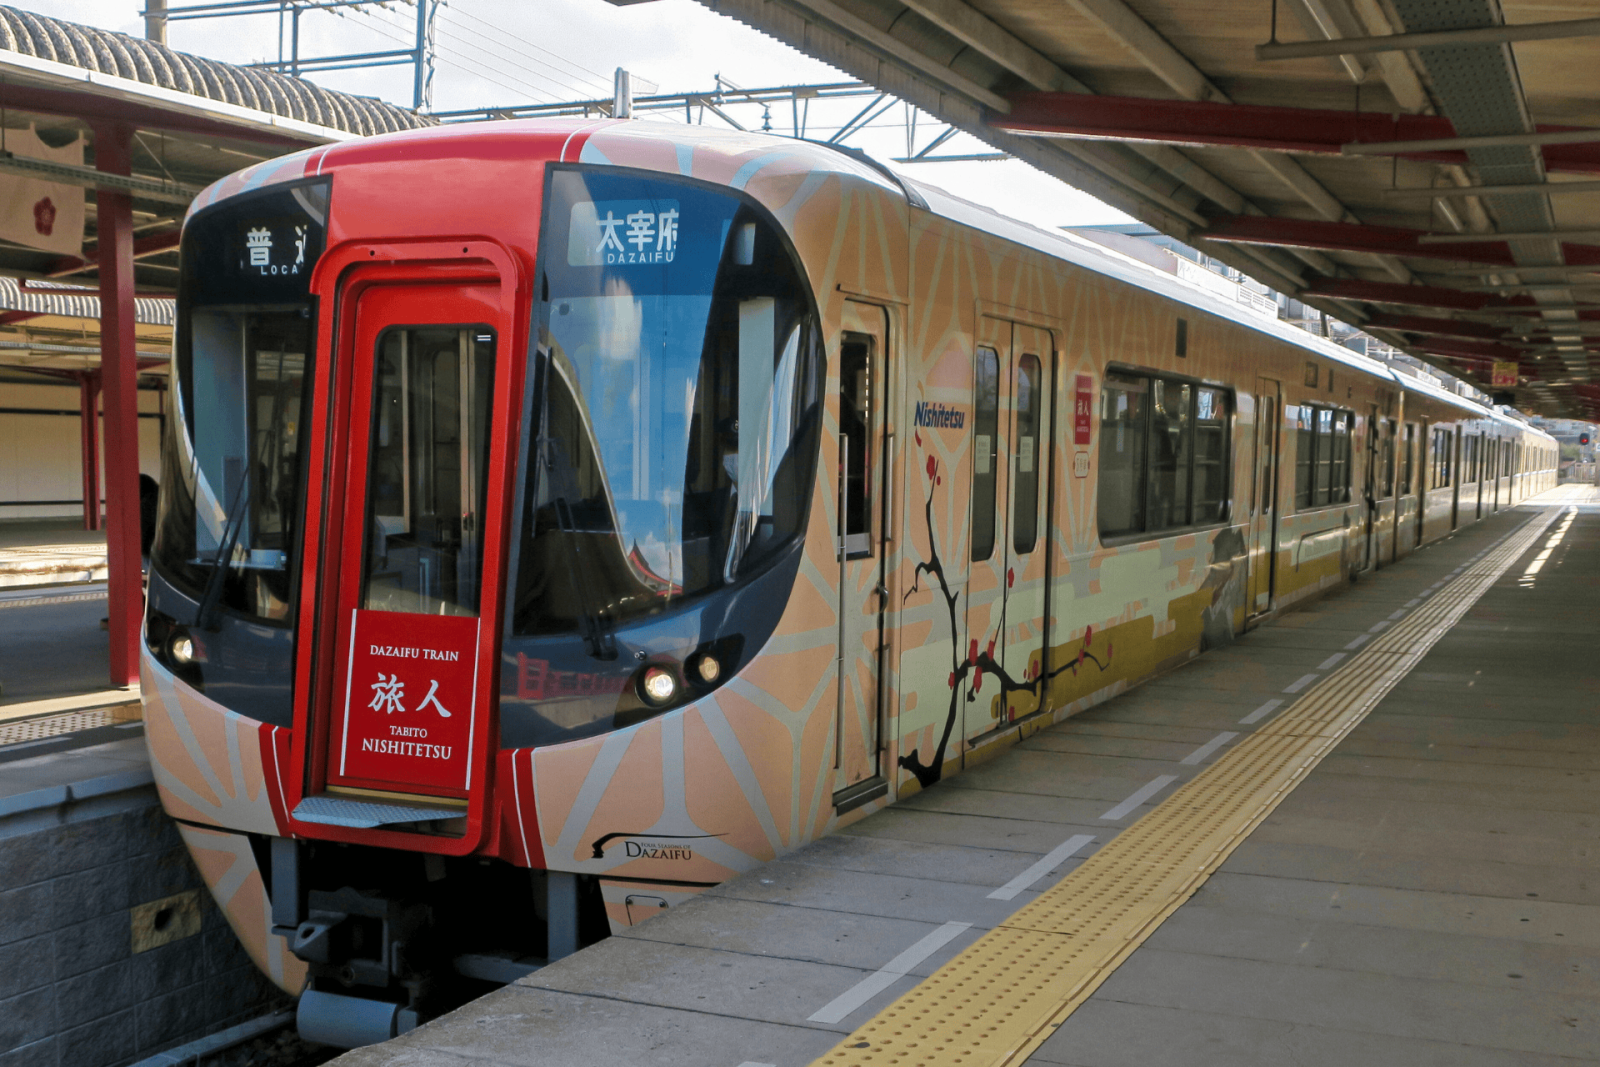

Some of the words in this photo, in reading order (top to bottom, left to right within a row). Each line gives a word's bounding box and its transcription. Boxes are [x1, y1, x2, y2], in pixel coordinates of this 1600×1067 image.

[596, 208, 679, 252] 太宰府
[607, 252, 674, 264] DAZAIFU
[914, 401, 965, 429] Nishitetsu
[369, 644, 420, 659] DAZAIFU
[423, 648, 459, 662] TRAIN
[367, 672, 452, 718] 旅人
[389, 725, 428, 738] TABITO
[361, 738, 452, 760] NISHITETSU
[624, 841, 692, 860] DAZAIFU
